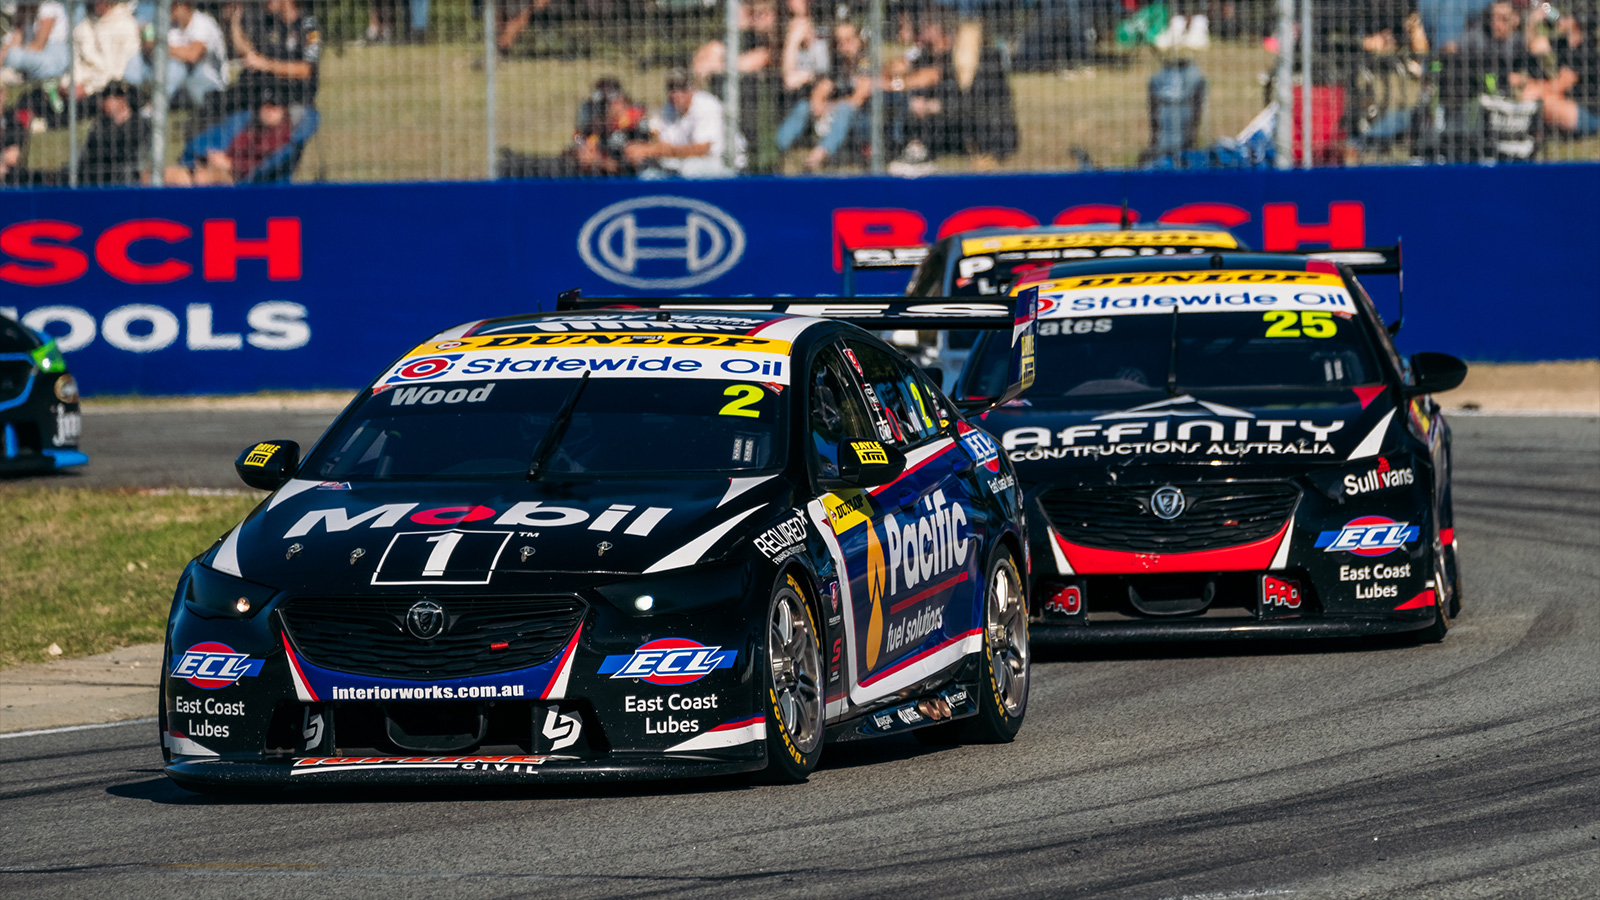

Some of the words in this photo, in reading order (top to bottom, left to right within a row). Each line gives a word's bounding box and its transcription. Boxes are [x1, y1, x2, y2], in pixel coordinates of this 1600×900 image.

[1077, 273, 1321, 286] DUNLOP
[1072, 292, 1278, 310] Statewide
[1293, 292, 1346, 306] Oil
[0, 301, 311, 352] OOLS
[1037, 318, 1112, 336] ates
[1263, 310, 1337, 338] 25
[478, 334, 771, 348] DUNLOP
[462, 355, 702, 375] Statewide
[720, 357, 782, 377] Oil
[390, 383, 496, 406] Wood
[718, 384, 765, 418] 2
[850, 441, 883, 451] DAYLE
[1010, 441, 1201, 462] CONSTRUCTIONS
[1207, 441, 1336, 455] AUSTRALIA
[1344, 463, 1414, 495] Sullivans
[836, 494, 863, 519] DUNLOP
[283, 501, 672, 538] Mobil
[753, 517, 807, 558] REQUIRED
[883, 489, 968, 596] Pacific
[1337, 526, 1404, 547] ECL
[421, 533, 463, 577] 1
[1340, 565, 1371, 581] East
[1373, 562, 1411, 579] Coast
[1262, 575, 1302, 608] PRO
[1355, 582, 1398, 599] Lubes
[886, 617, 905, 653] fuel
[905, 604, 944, 643] solutions
[177, 653, 240, 677] ECL
[626, 650, 714, 675] ECL
[333, 684, 525, 700] interiorworks.com.au
[625, 695, 664, 713] East
[668, 693, 718, 711] Coast
[175, 696, 202, 714] East
[204, 697, 245, 716] Coast
[188, 719, 230, 738] Lubes
[646, 716, 699, 734] Lubes
[769, 687, 802, 765] DUNLOP
[461, 763, 539, 775] CIVIL
